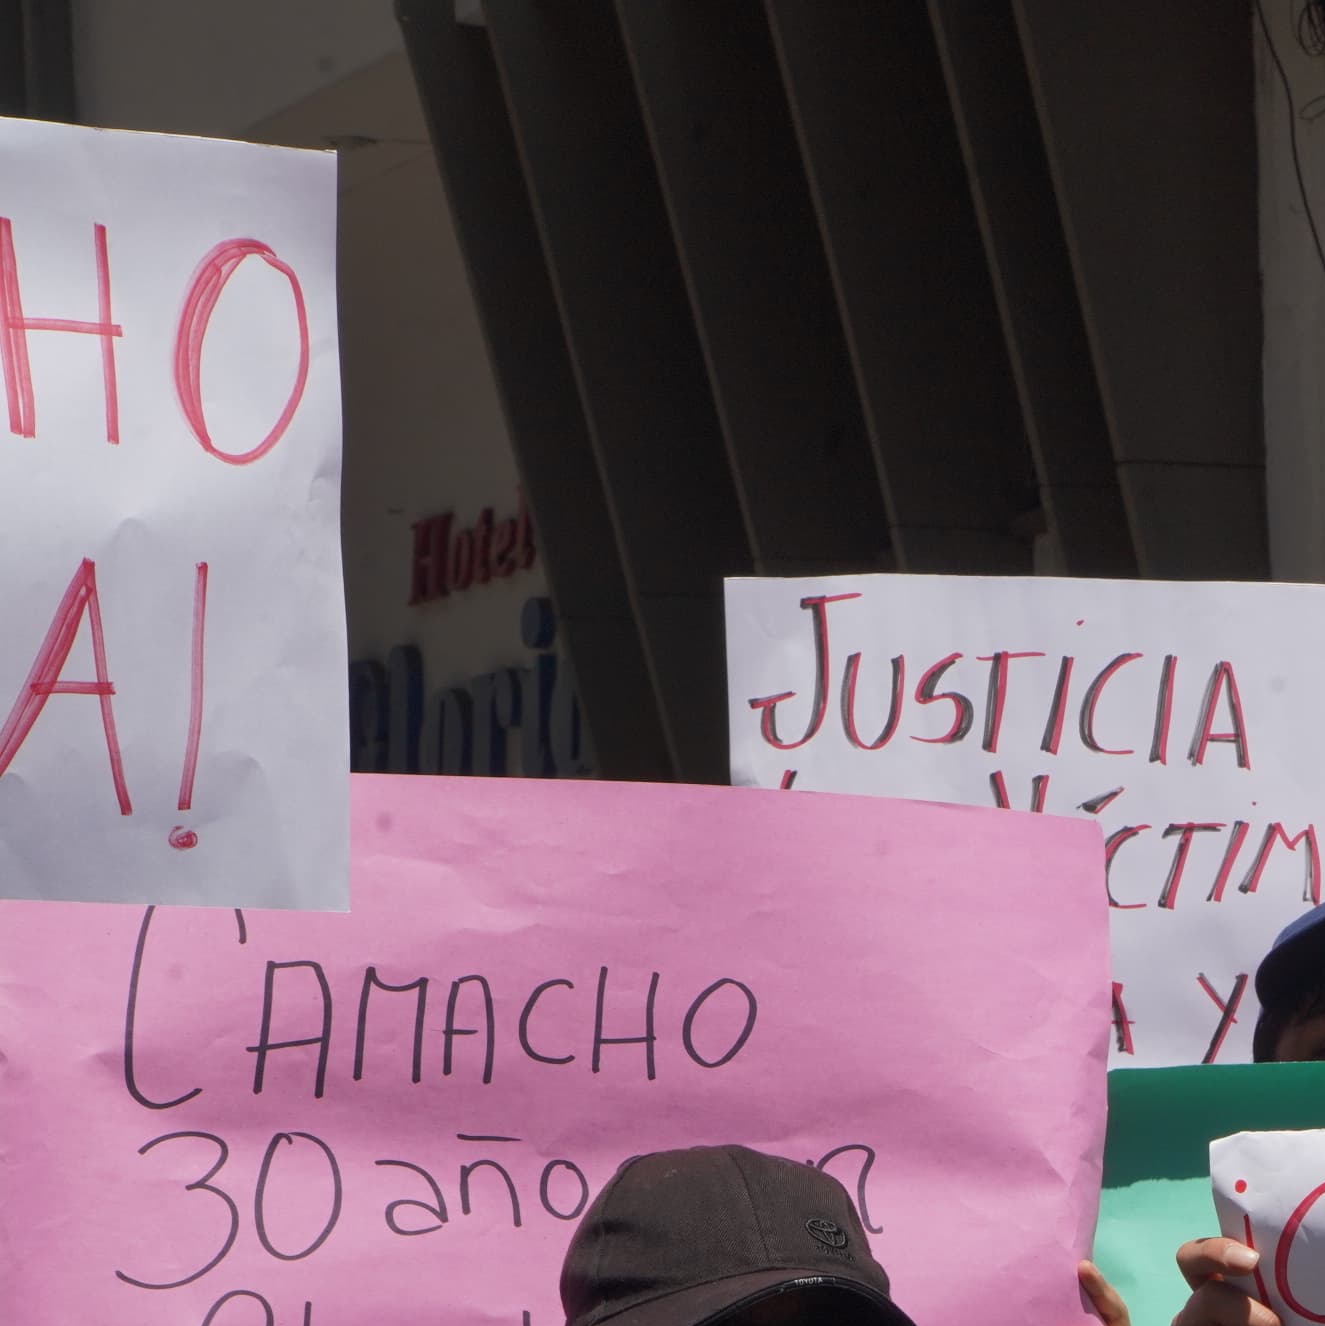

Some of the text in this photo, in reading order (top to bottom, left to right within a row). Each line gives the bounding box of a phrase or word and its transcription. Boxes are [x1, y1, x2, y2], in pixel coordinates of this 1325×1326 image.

[748, 592, 1252, 772] JUSTICIA
[124, 905, 758, 1110] CAMACHO
[116, 1131, 342, 1290] 30
[375, 1132, 590, 1236] año
